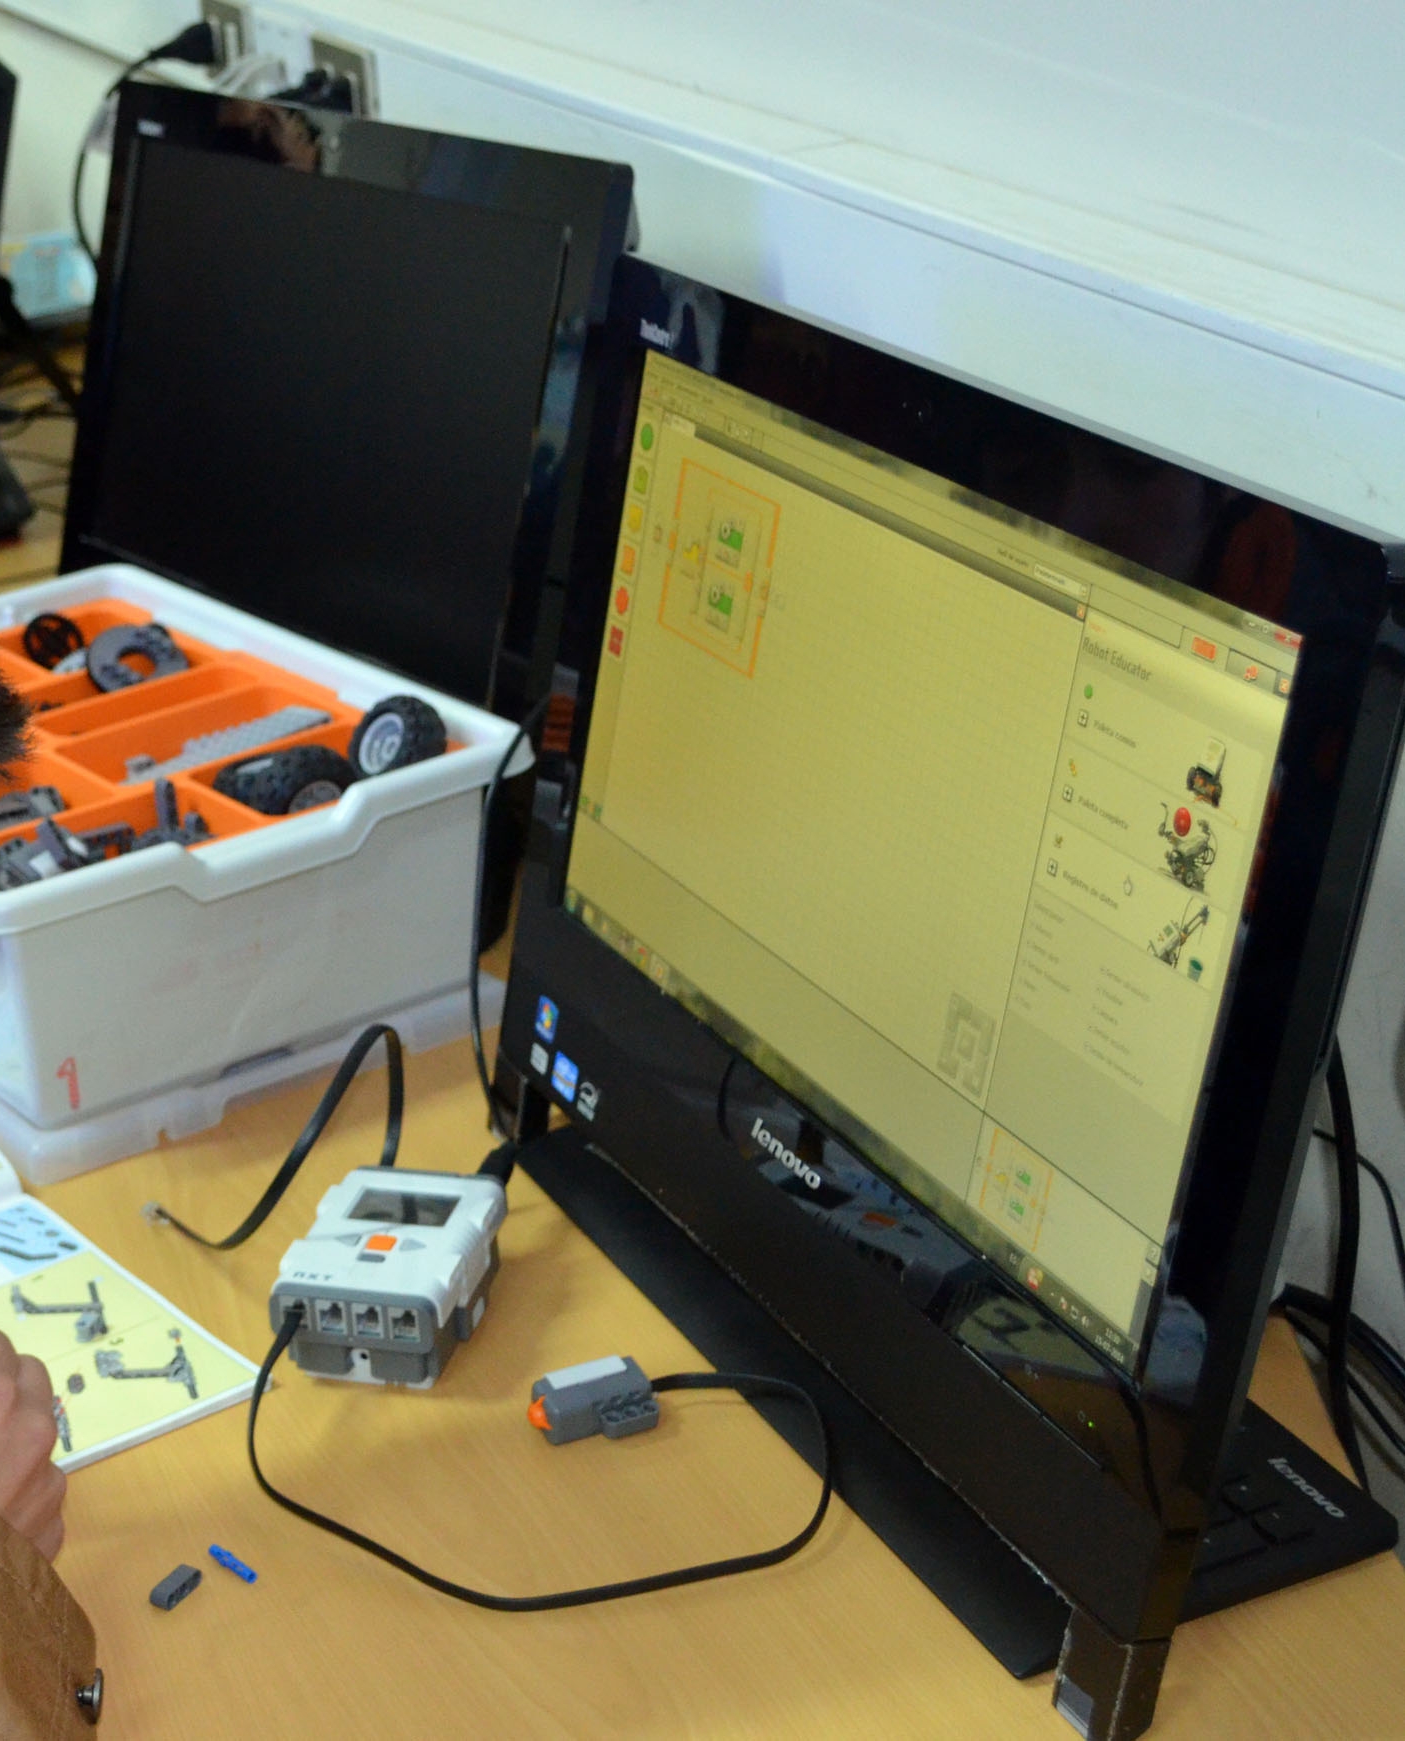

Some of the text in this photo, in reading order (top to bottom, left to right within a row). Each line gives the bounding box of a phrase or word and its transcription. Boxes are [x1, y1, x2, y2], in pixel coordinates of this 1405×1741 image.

[1082, 637, 1153, 682] Robot Educator
[56, 1056, 80, 1111] 1
[751, 1117, 821, 1190] lenovo
[1267, 1457, 1345, 1518] lenovo
